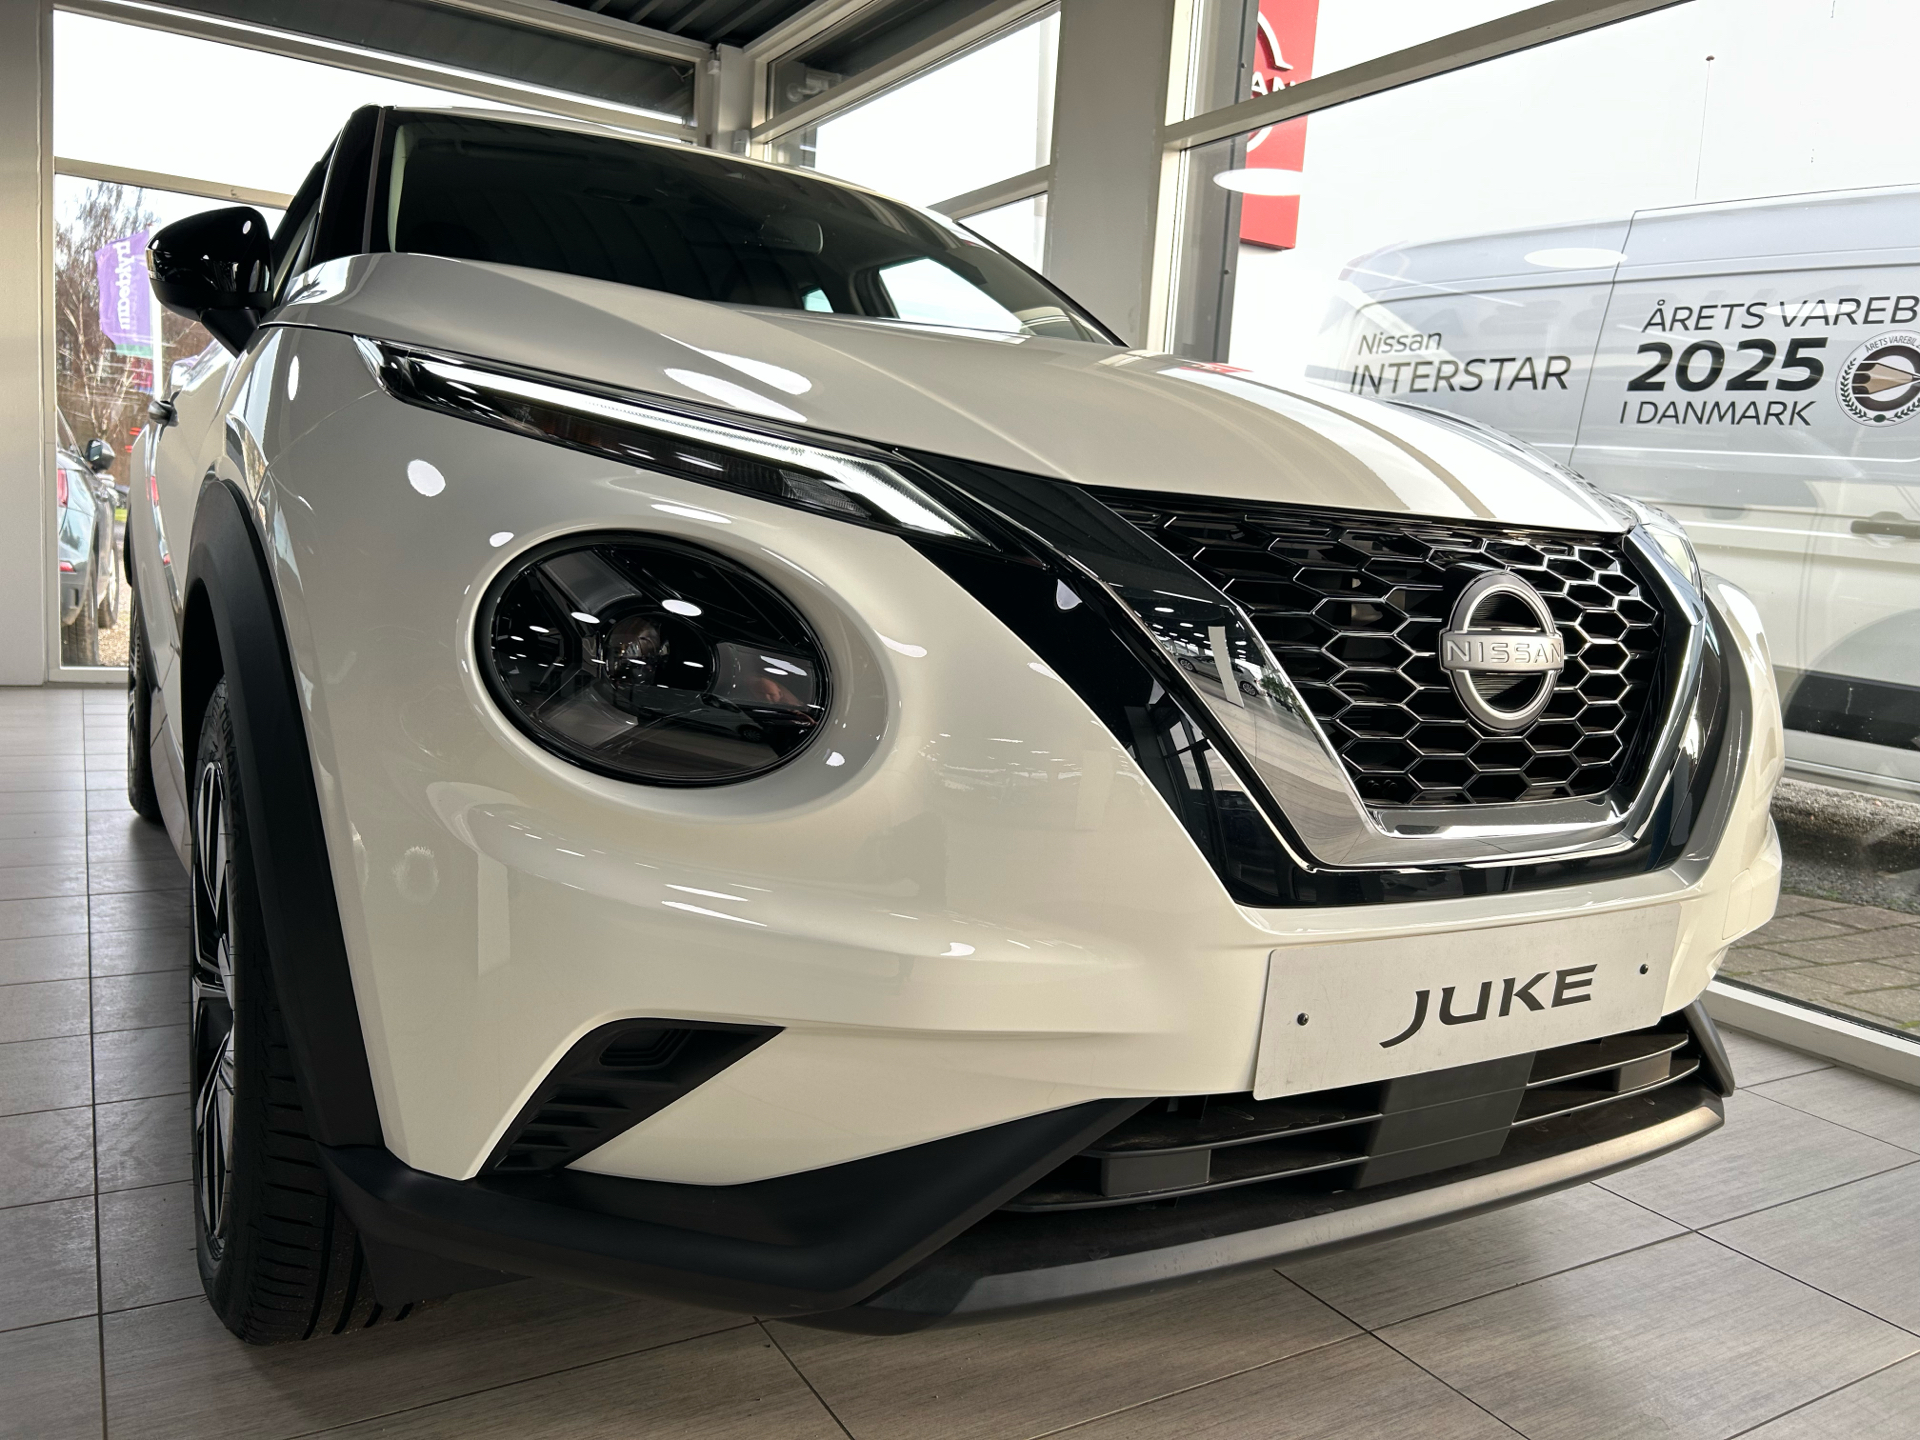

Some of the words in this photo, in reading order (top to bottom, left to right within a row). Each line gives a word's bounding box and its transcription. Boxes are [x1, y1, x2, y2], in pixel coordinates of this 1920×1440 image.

[1641, 299, 1767, 333] ÅRETS
[1779, 295, 1920, 328] VAREB
[1357, 332, 1443, 356] Nissan
[1350, 355, 1572, 396] INTERSTAR
[1626, 336, 1829, 392] 2025
[1619, 401, 1628, 425] I
[1636, 400, 1817, 426] DANMARK
[1447, 640, 1563, 664] NISSAN
[1379, 963, 1598, 1049] JUKE
